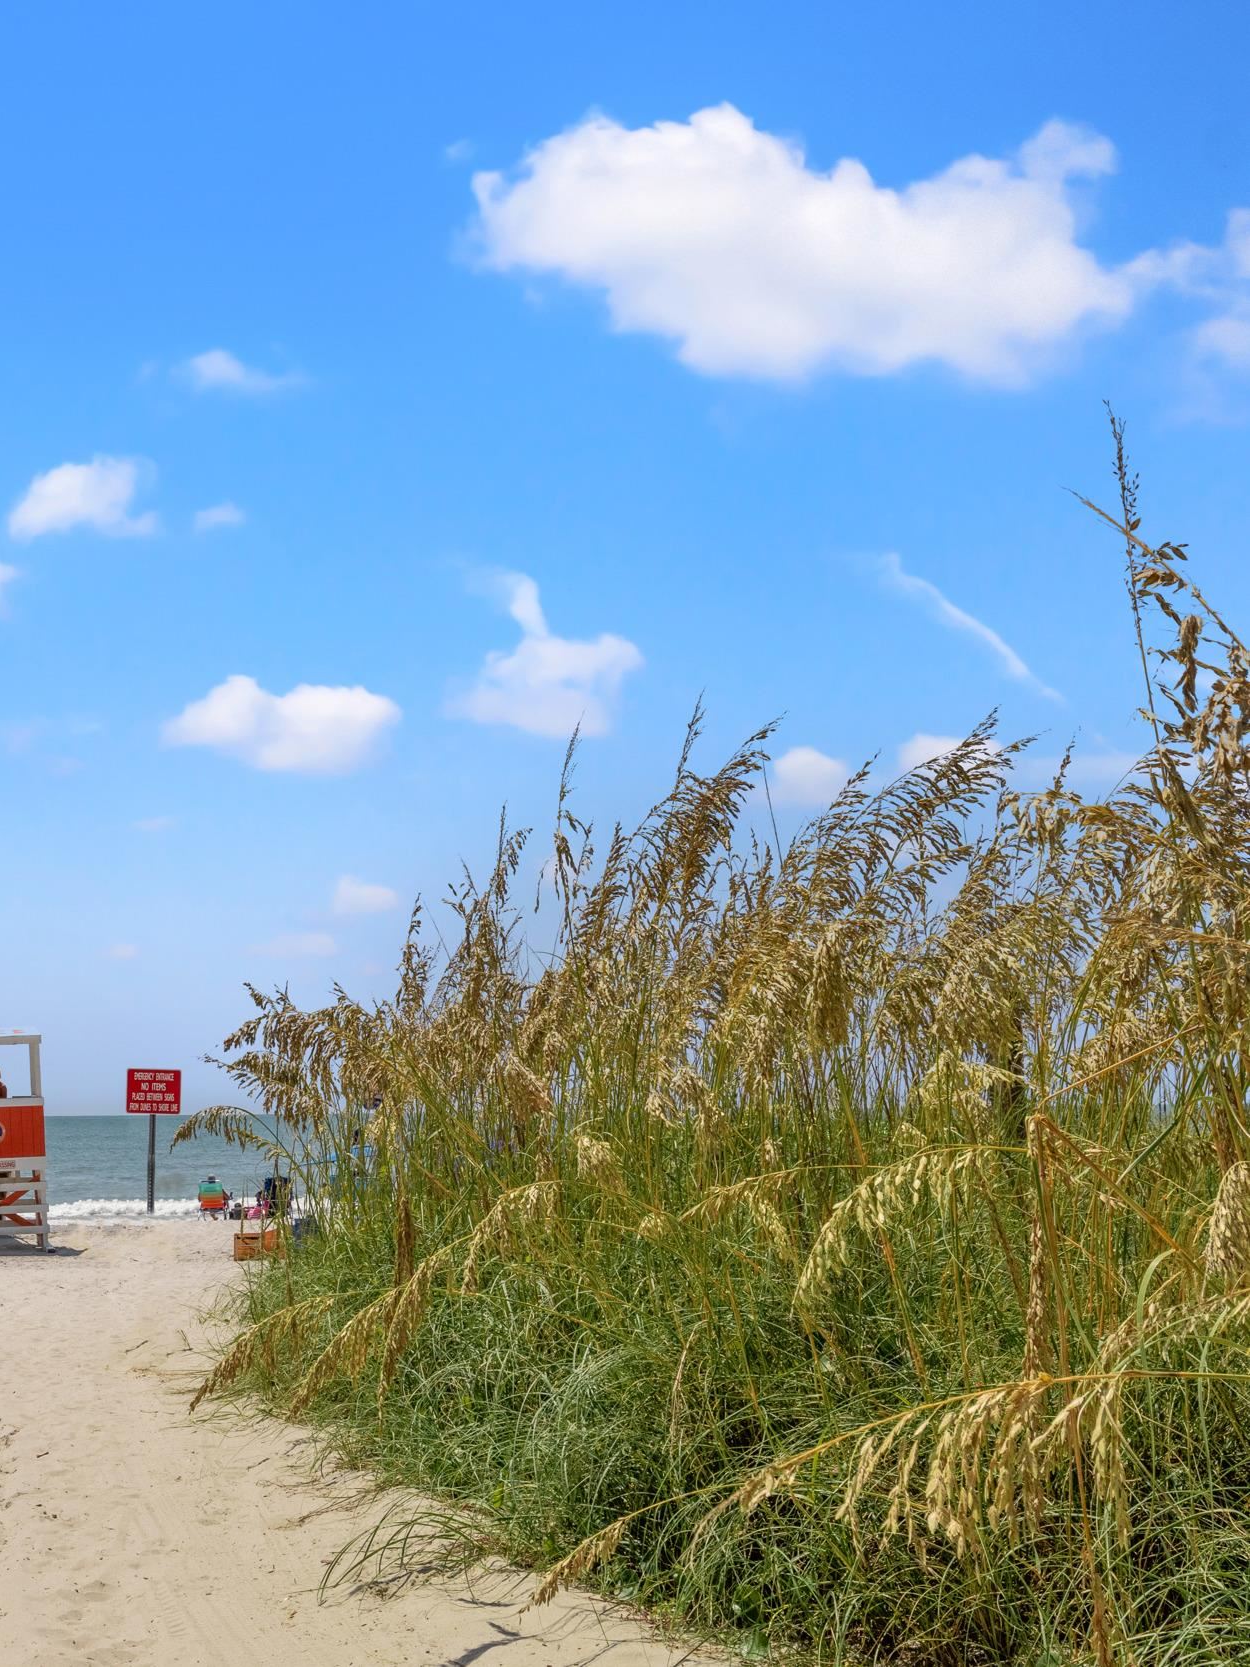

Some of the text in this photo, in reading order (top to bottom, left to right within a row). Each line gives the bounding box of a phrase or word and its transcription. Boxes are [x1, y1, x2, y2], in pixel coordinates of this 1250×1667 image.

[134, 1072, 175, 1081] EMERGENCY ENTRANCE
[141, 1082, 167, 1091] NO ITEMS
[131, 1092, 175, 1102] PLACED BETWEEN SIGNS
[129, 1103, 178, 1112] FROM DUNES TO SHORE LINE
